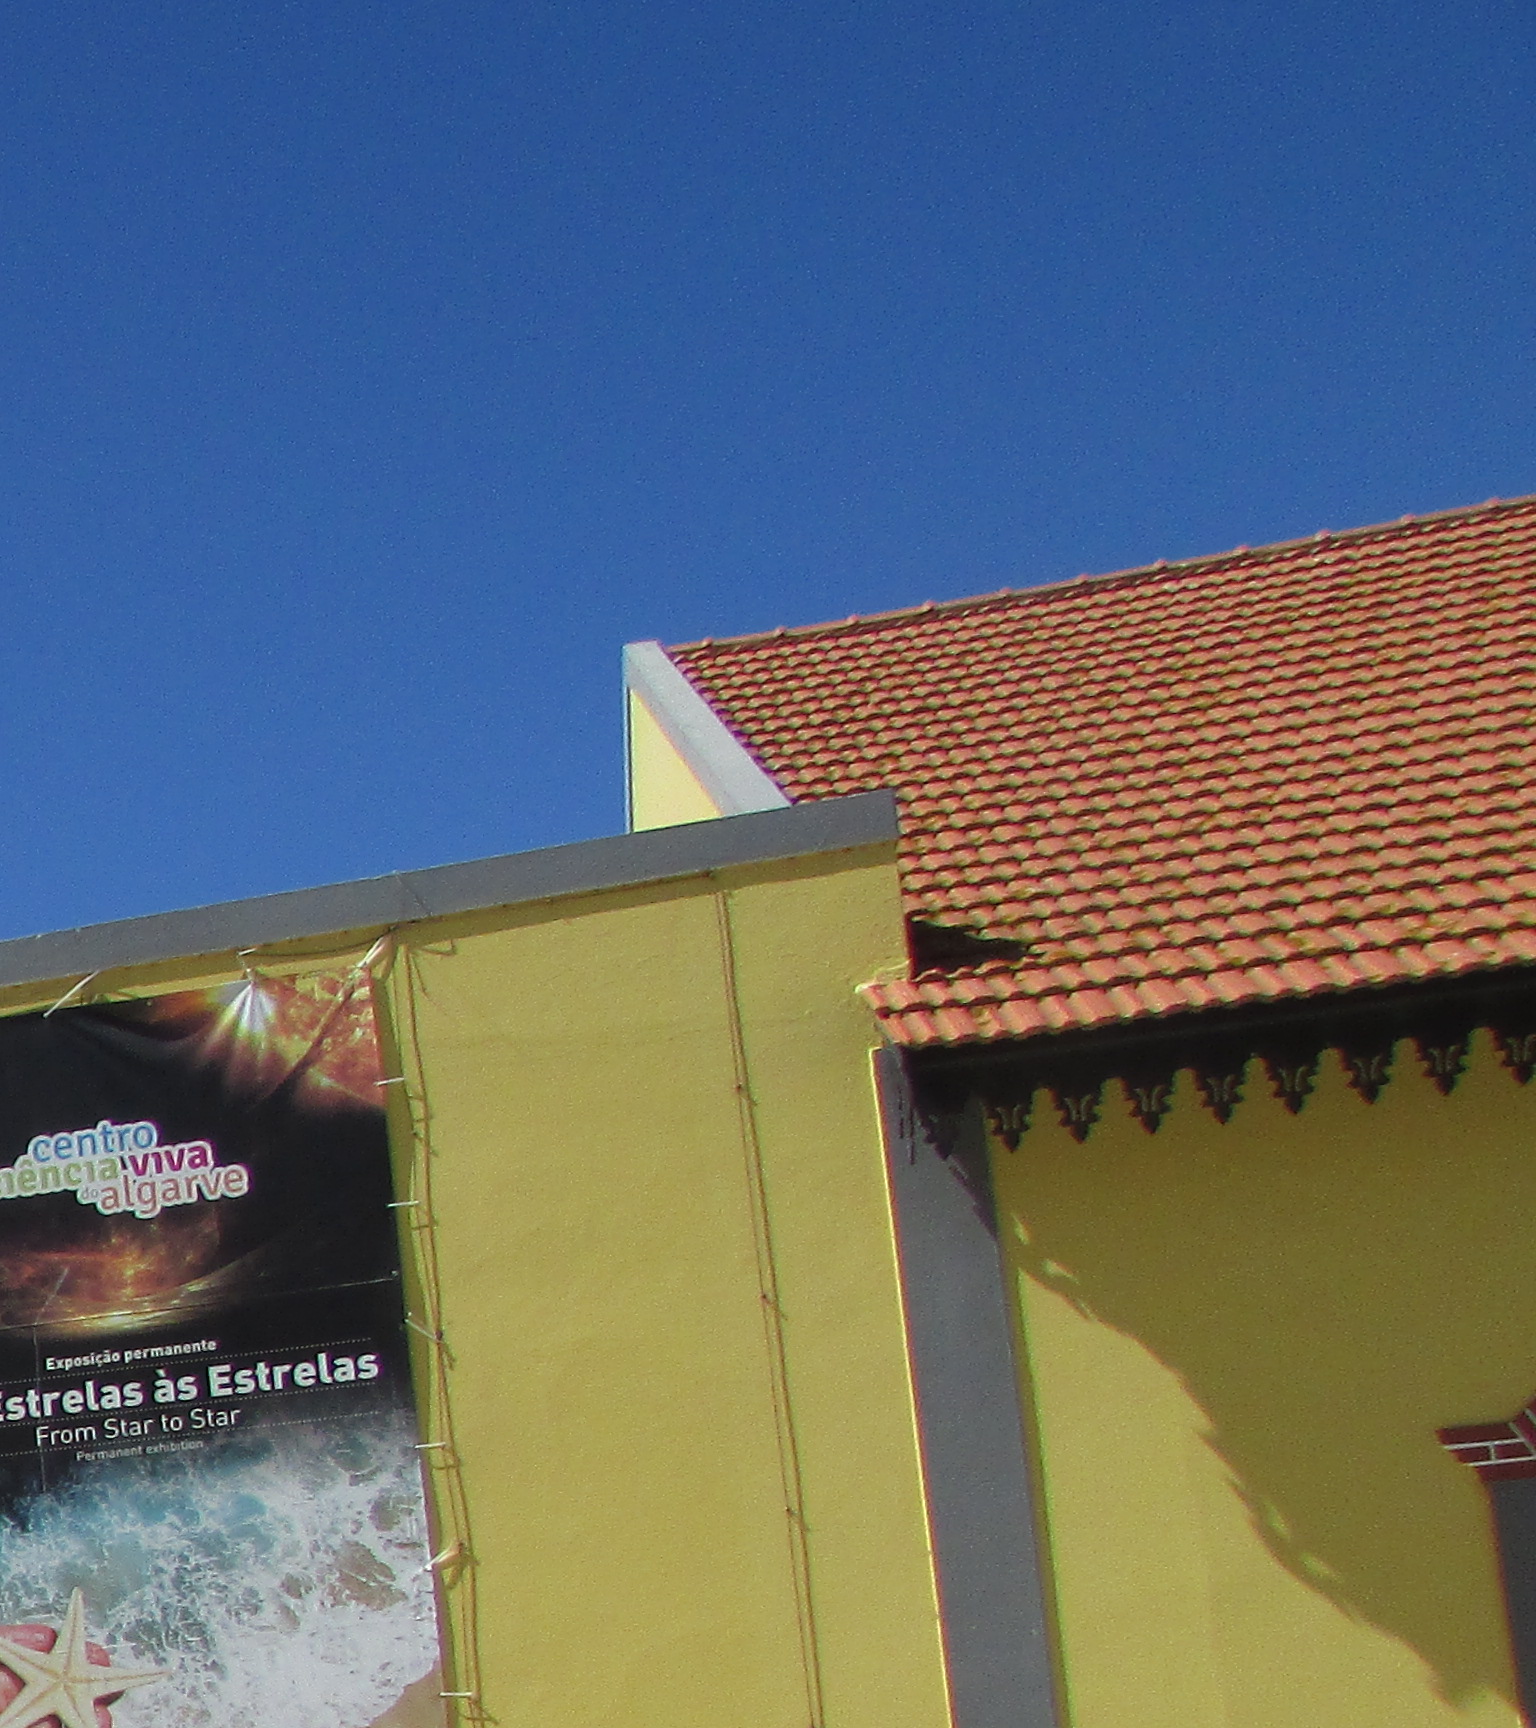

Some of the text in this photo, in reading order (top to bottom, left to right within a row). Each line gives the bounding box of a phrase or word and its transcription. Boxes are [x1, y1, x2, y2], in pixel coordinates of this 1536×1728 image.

[32, 1122, 154, 1162] centro
[127, 1145, 209, 1176] viva
[81, 1174, 245, 1214] do algarve
[45, 1339, 218, 1371] Exposição permanente
[154, 1368, 198, 1404] às
[207, 1352, 380, 1398] Estrelas
[35, 1407, 241, 1447] From Star to Star
[76, 1438, 204, 1462] Permanent exhibition
